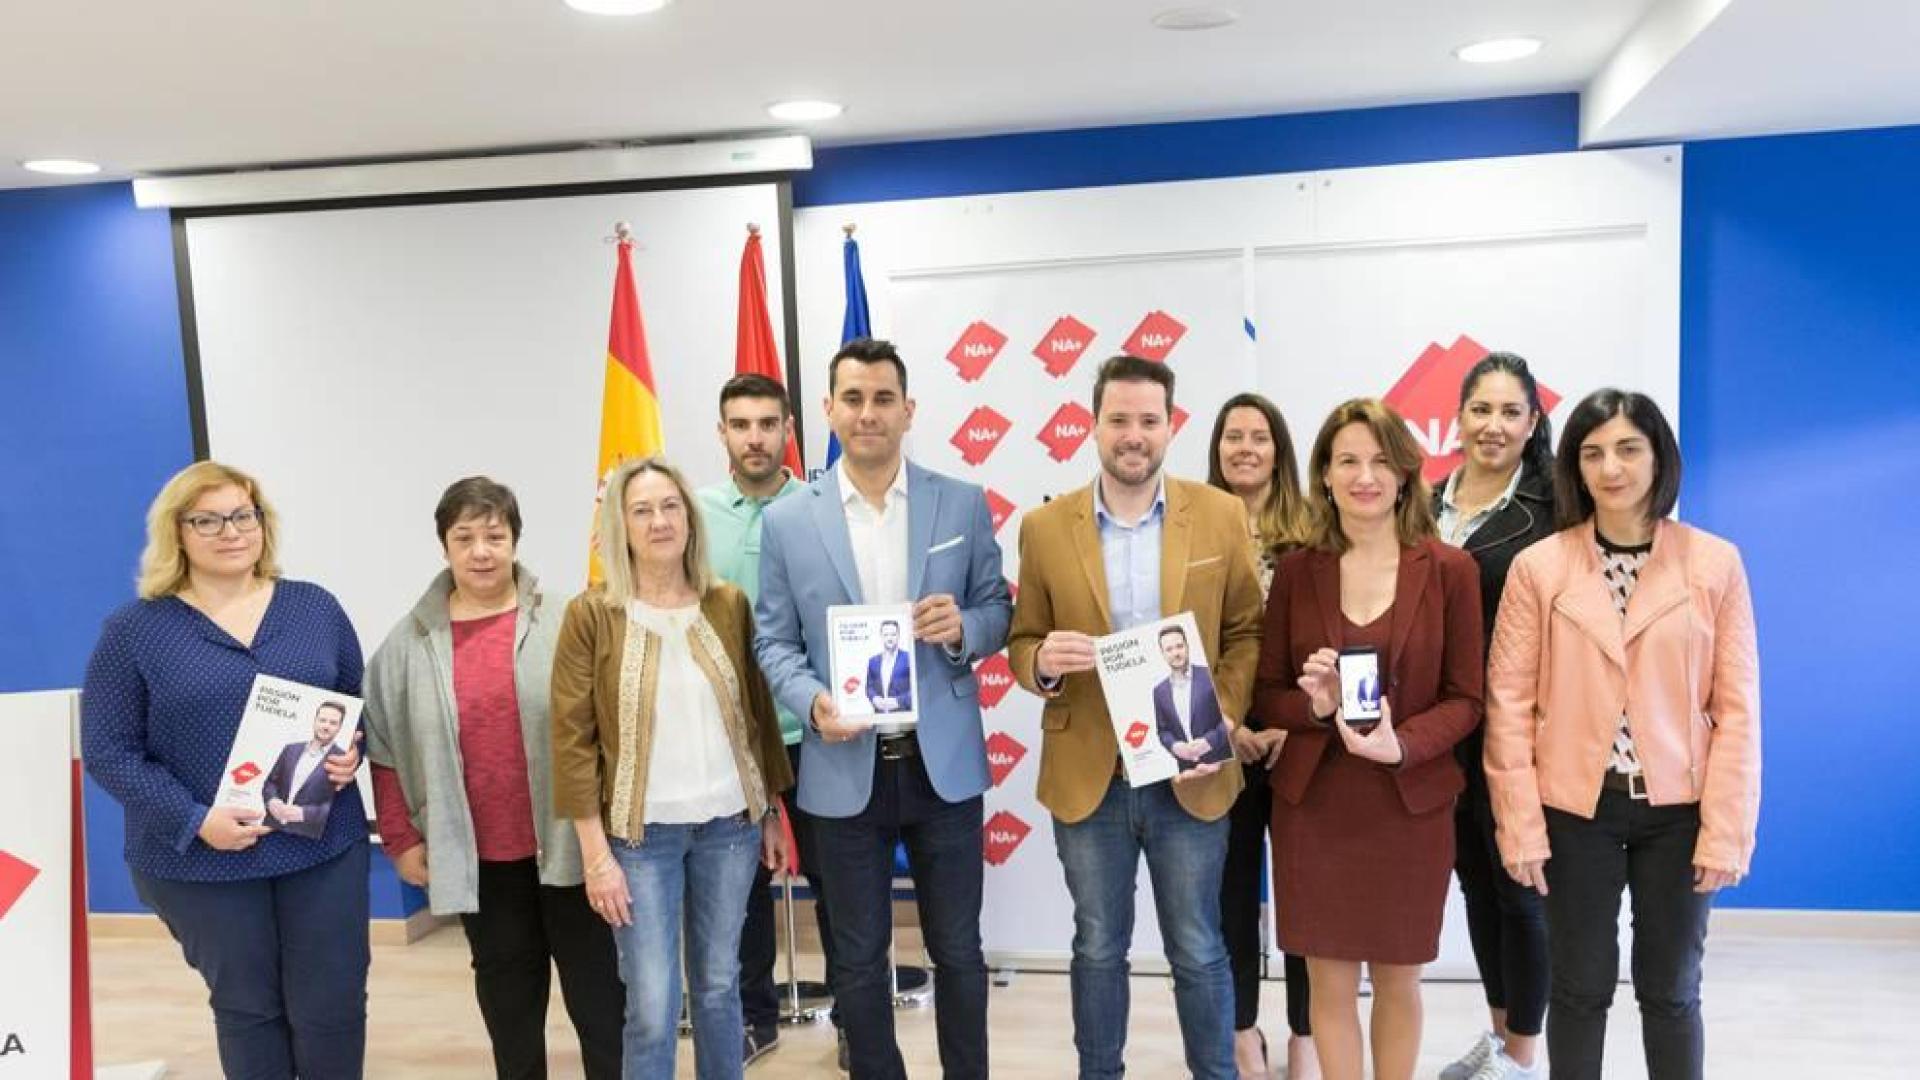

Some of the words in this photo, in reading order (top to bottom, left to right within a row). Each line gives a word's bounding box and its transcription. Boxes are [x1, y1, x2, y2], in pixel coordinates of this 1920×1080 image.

[1052, 339, 1082, 352] NA+
[1141, 334, 1172, 347] NA+
[964, 343, 994, 356] NA+
[968, 428, 998, 441] NA+
[1055, 423, 1087, 437] NA+
[981, 673, 1010, 686] NA+
[990, 831, 1018, 843] NA+
